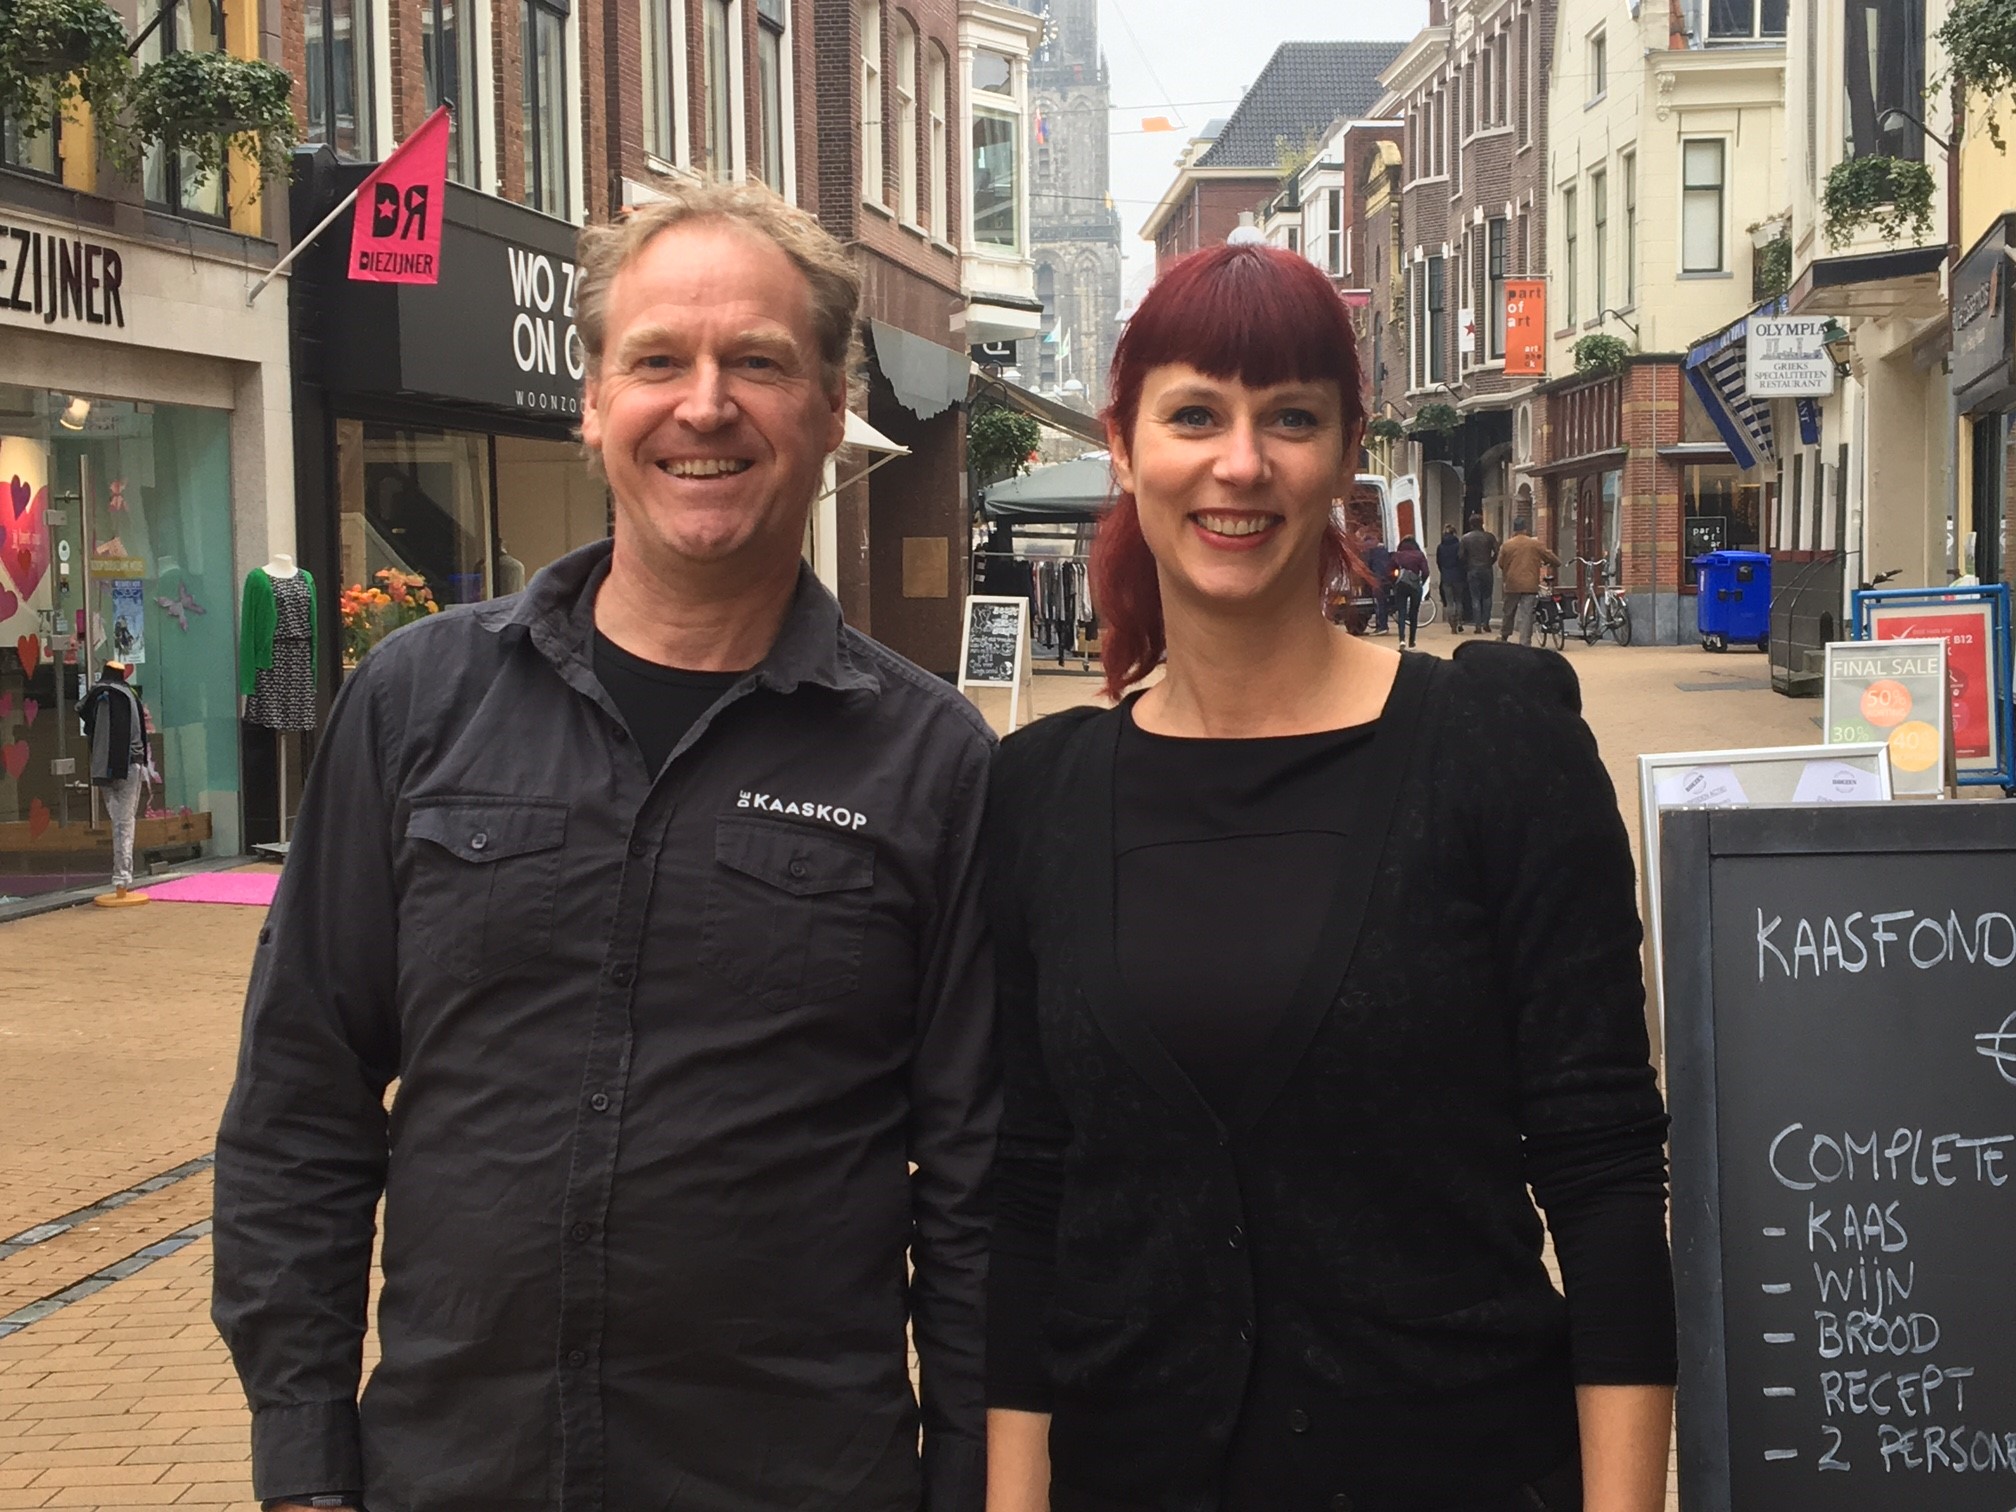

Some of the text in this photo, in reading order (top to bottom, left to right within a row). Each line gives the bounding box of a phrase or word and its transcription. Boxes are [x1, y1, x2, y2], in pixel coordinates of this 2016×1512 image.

[359, 250, 434, 275] DIEZIJNER
[508, 247, 555, 313] WO
[1508, 287, 1542, 301] part
[1507, 301, 1524, 314] of
[1507, 316, 1530, 328] art
[1755, 323, 1827, 337] OLYMPIA
[513, 313, 556, 375] ON
[1754, 371, 1828, 381] SPECIALITEITEN
[1773, 363, 1809, 371] GRIEKS
[1759, 380, 1822, 389] RESTAURANT
[1953, 634, 1973, 645] B12
[1832, 658, 1939, 677] FINAL SALE
[1867, 689, 1907, 707] 50%
[1832, 725, 1869, 742] 30%
[737, 789, 867, 830] DE KAASKOP
[1757, 907, 2016, 982] KAASFOND
[1769, 1122, 2014, 1190] COMPLETE
[1808, 1200, 1908, 1252] KAAS
[1814, 1310, 1941, 1358] BROOD
[1819, 1364, 1975, 1416] RECEPT
[1818, 1425, 1850, 1472] 2
